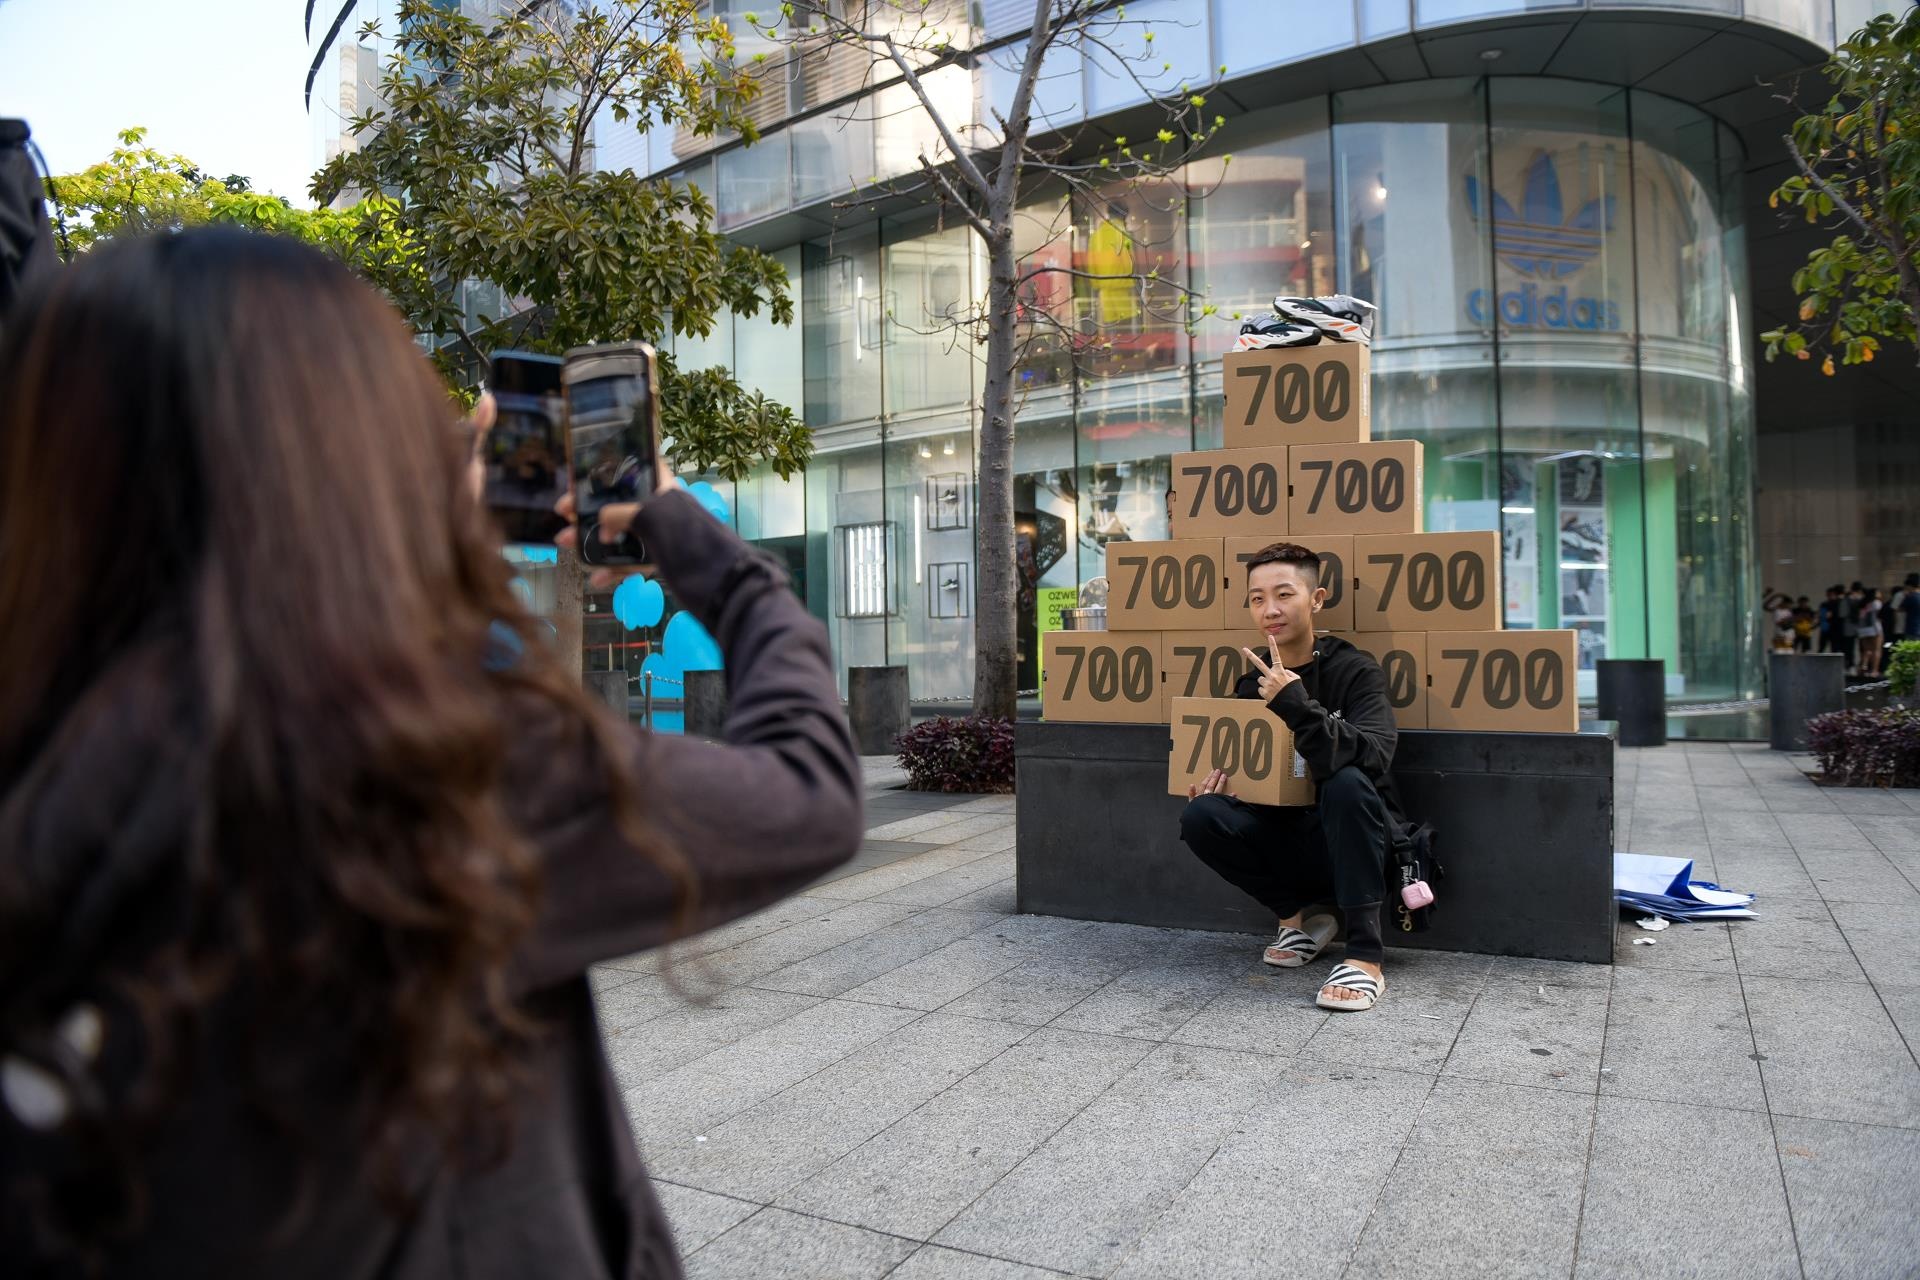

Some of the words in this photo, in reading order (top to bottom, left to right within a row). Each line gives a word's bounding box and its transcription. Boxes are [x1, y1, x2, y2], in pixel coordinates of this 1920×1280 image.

[1467, 282, 1621, 330] adidas
[1236, 361, 1350, 426] 700
[1182, 463, 1278, 517] 700
[1300, 458, 1404, 514] 700
[1048, 590, 1077, 601] OZWE
[1117, 554, 1216, 610] 700
[1368, 551, 1484, 612] 700
[1056, 646, 1153, 702] 700
[1173, 646, 1268, 697] 70
[1441, 649, 1563, 710] 700
[1182, 715, 1273, 781] 700
